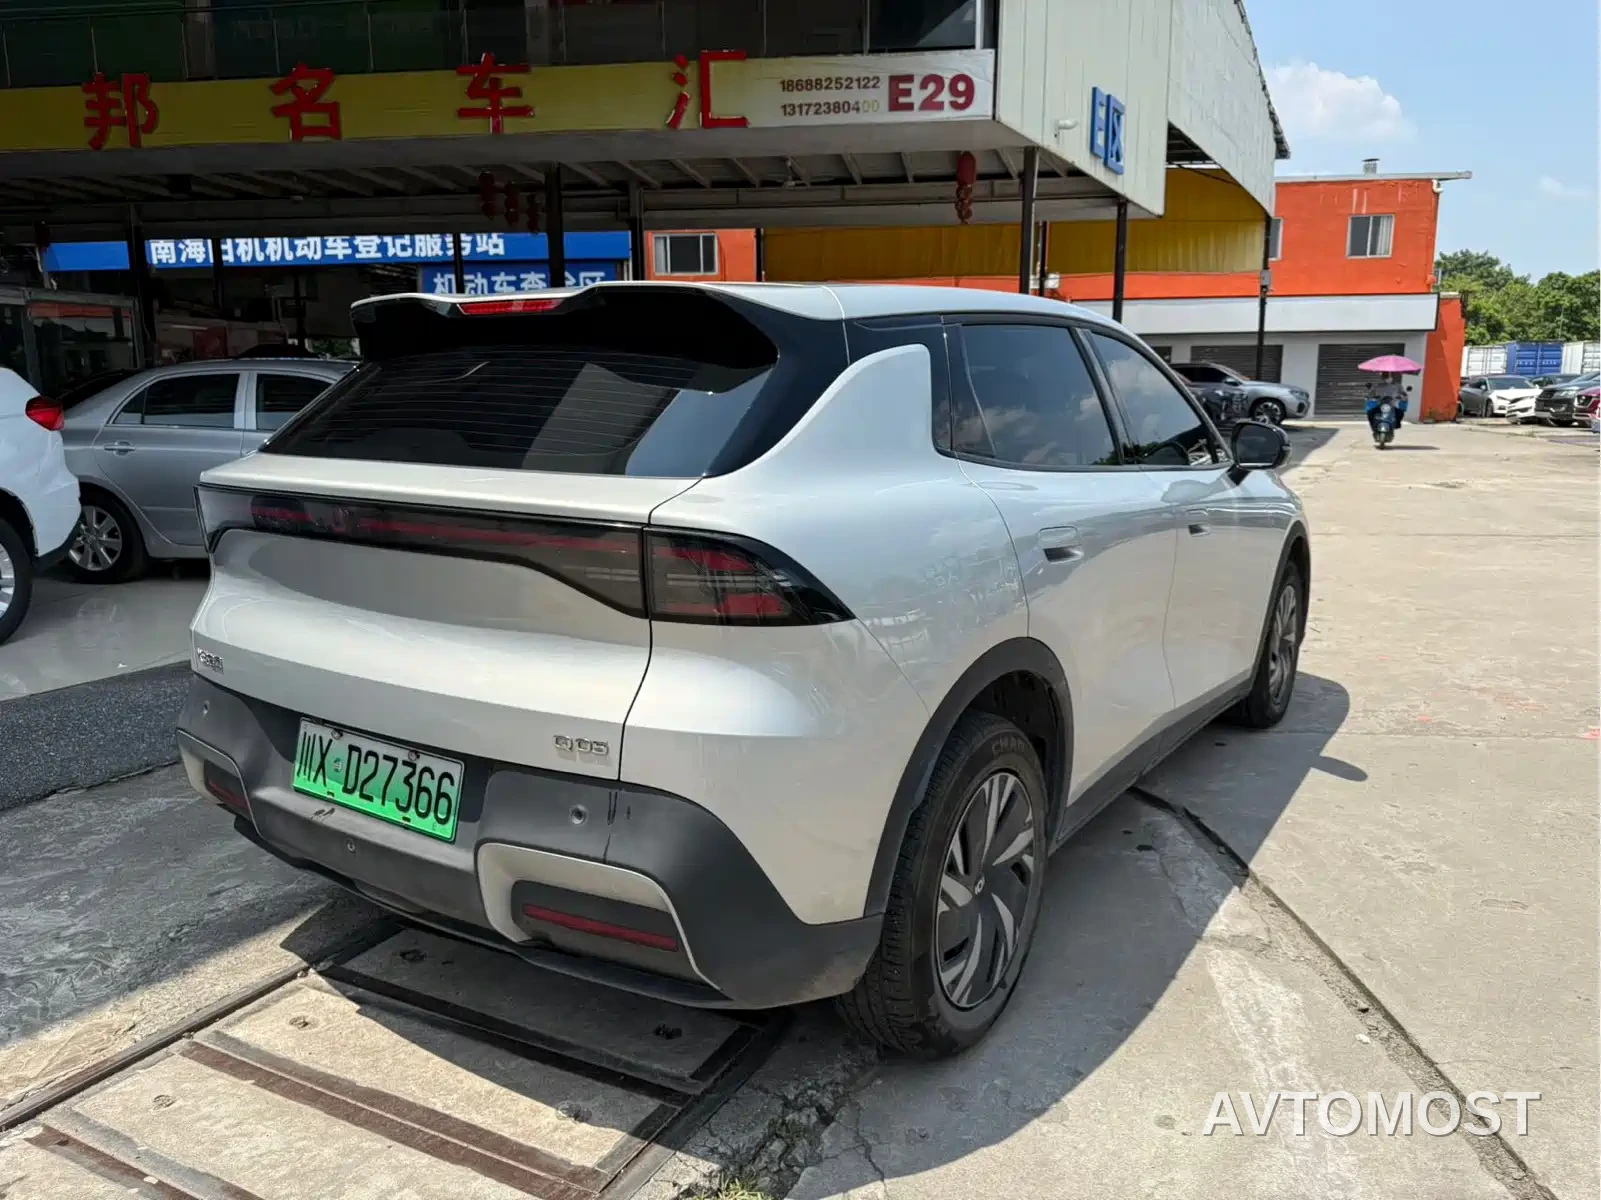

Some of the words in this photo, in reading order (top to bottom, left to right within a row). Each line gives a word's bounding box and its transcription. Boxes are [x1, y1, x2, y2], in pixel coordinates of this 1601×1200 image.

[780, 76, 880, 92] 18688252122
[888, 74, 975, 112] E29
[82, 50, 748, 151] 邦名车汇
[780, 100, 880, 116] 13172380400
